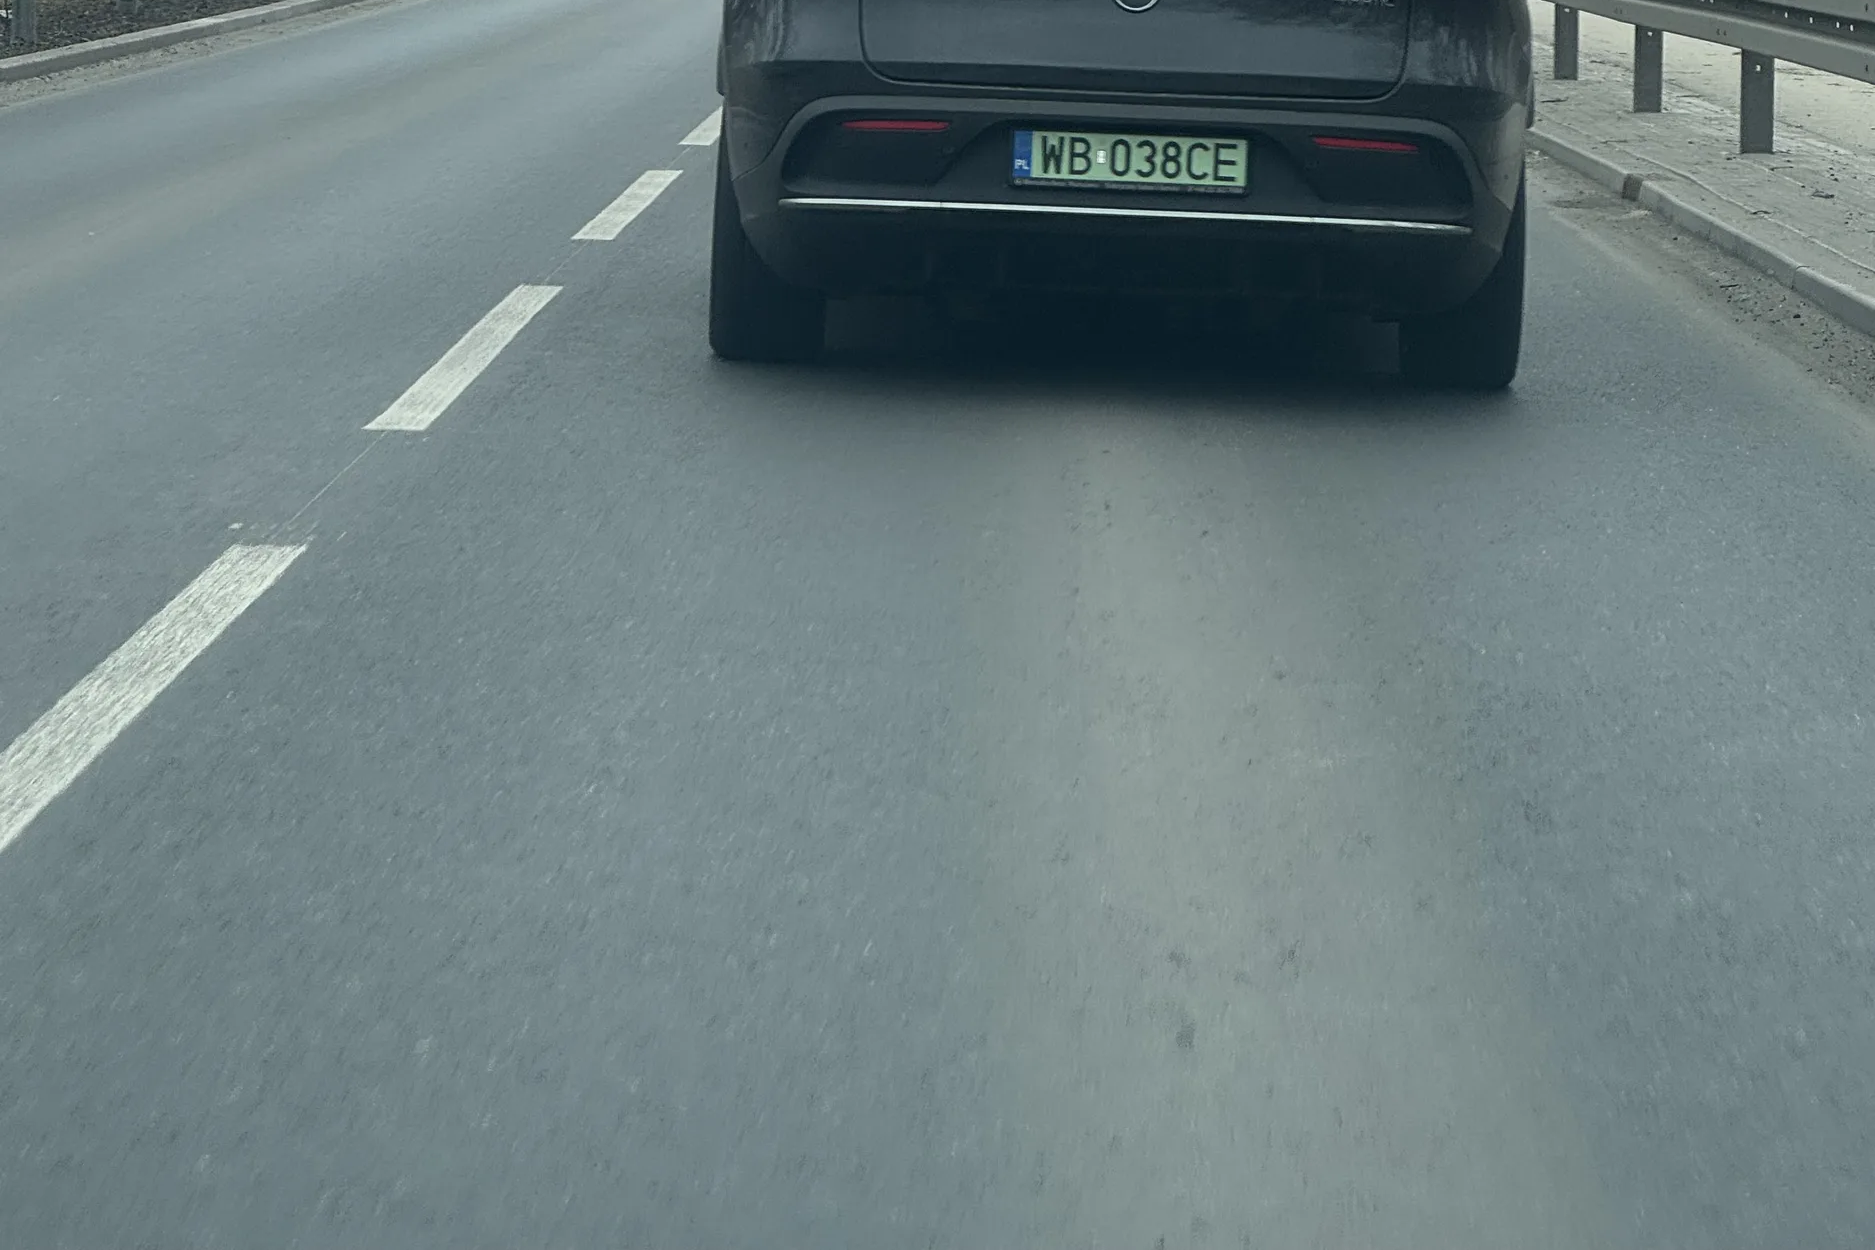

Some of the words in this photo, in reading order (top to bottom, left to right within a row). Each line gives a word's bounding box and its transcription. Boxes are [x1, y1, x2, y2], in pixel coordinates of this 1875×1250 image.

[1014, 159, 1030, 171] PL
[1041, 135, 1092, 176] WB
[1109, 138, 1239, 183] 038CE
